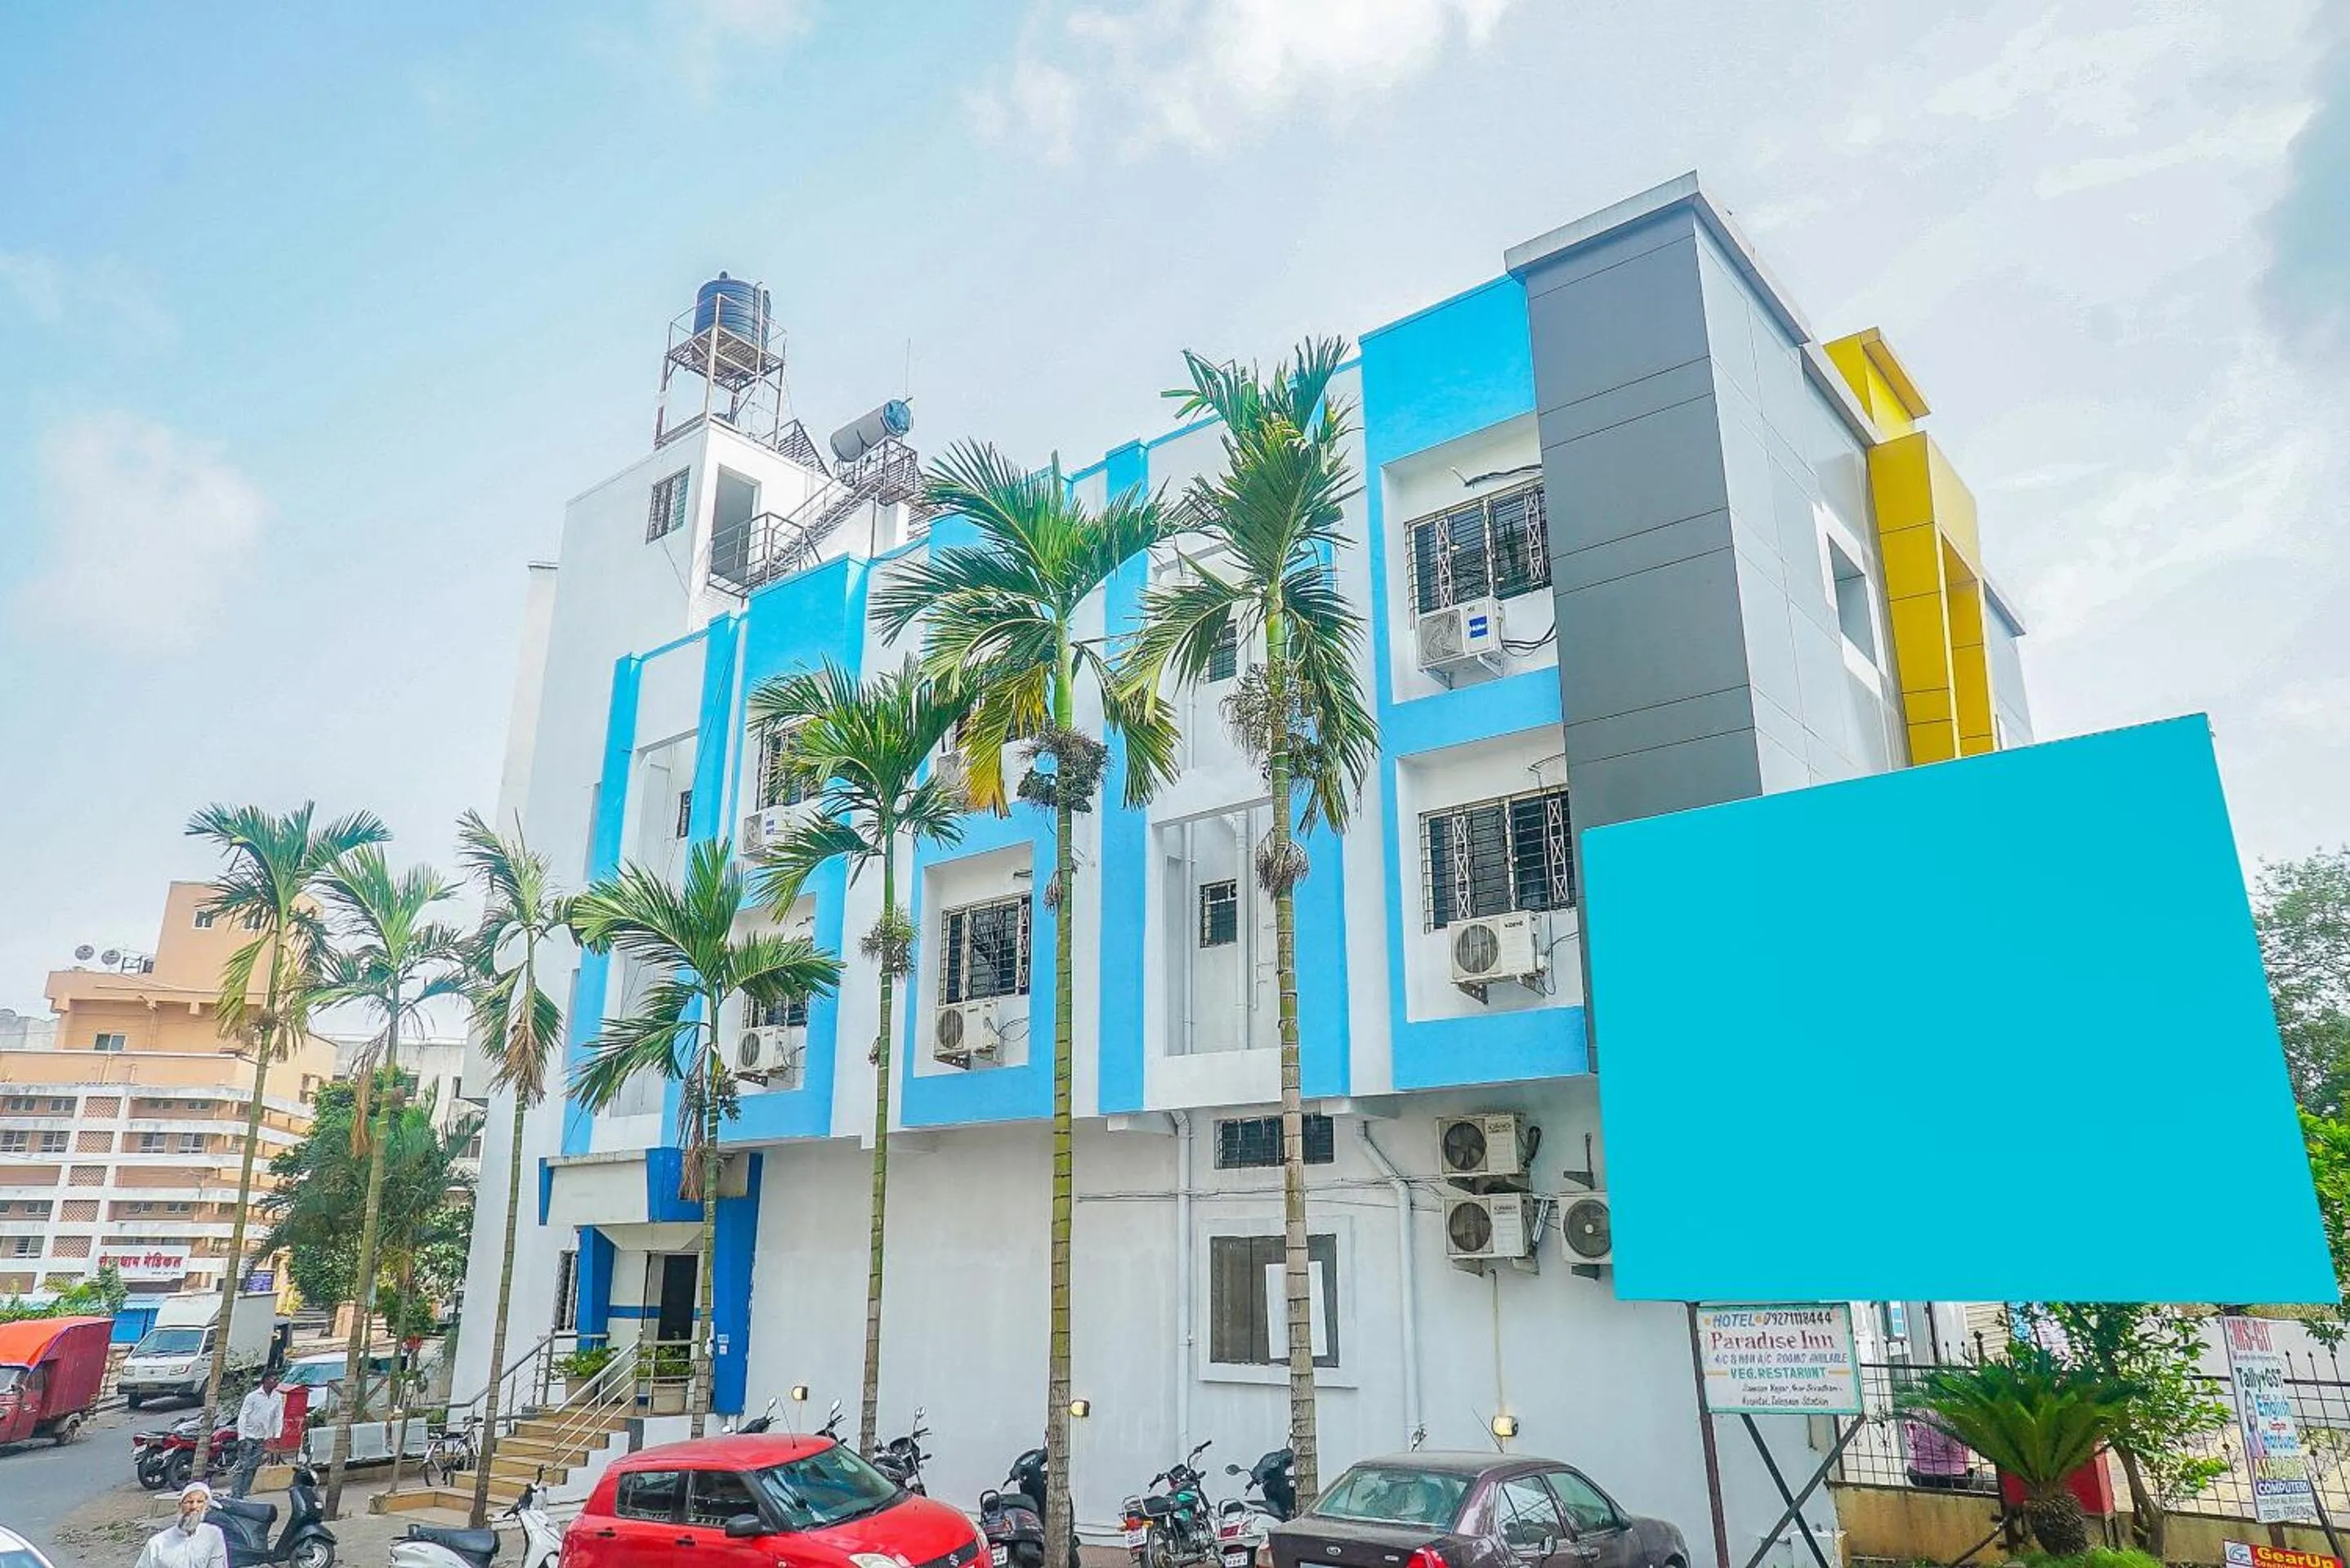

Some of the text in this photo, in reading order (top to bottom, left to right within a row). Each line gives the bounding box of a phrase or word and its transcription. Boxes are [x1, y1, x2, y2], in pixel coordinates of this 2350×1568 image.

[1713, 1312, 1755, 1328] HOTEL
[1710, 1329, 1834, 1350] Paradise Inn
[1776, 1352, 1806, 1364] ROOMS
[2258, 1547, 2334, 1568] GearUp
